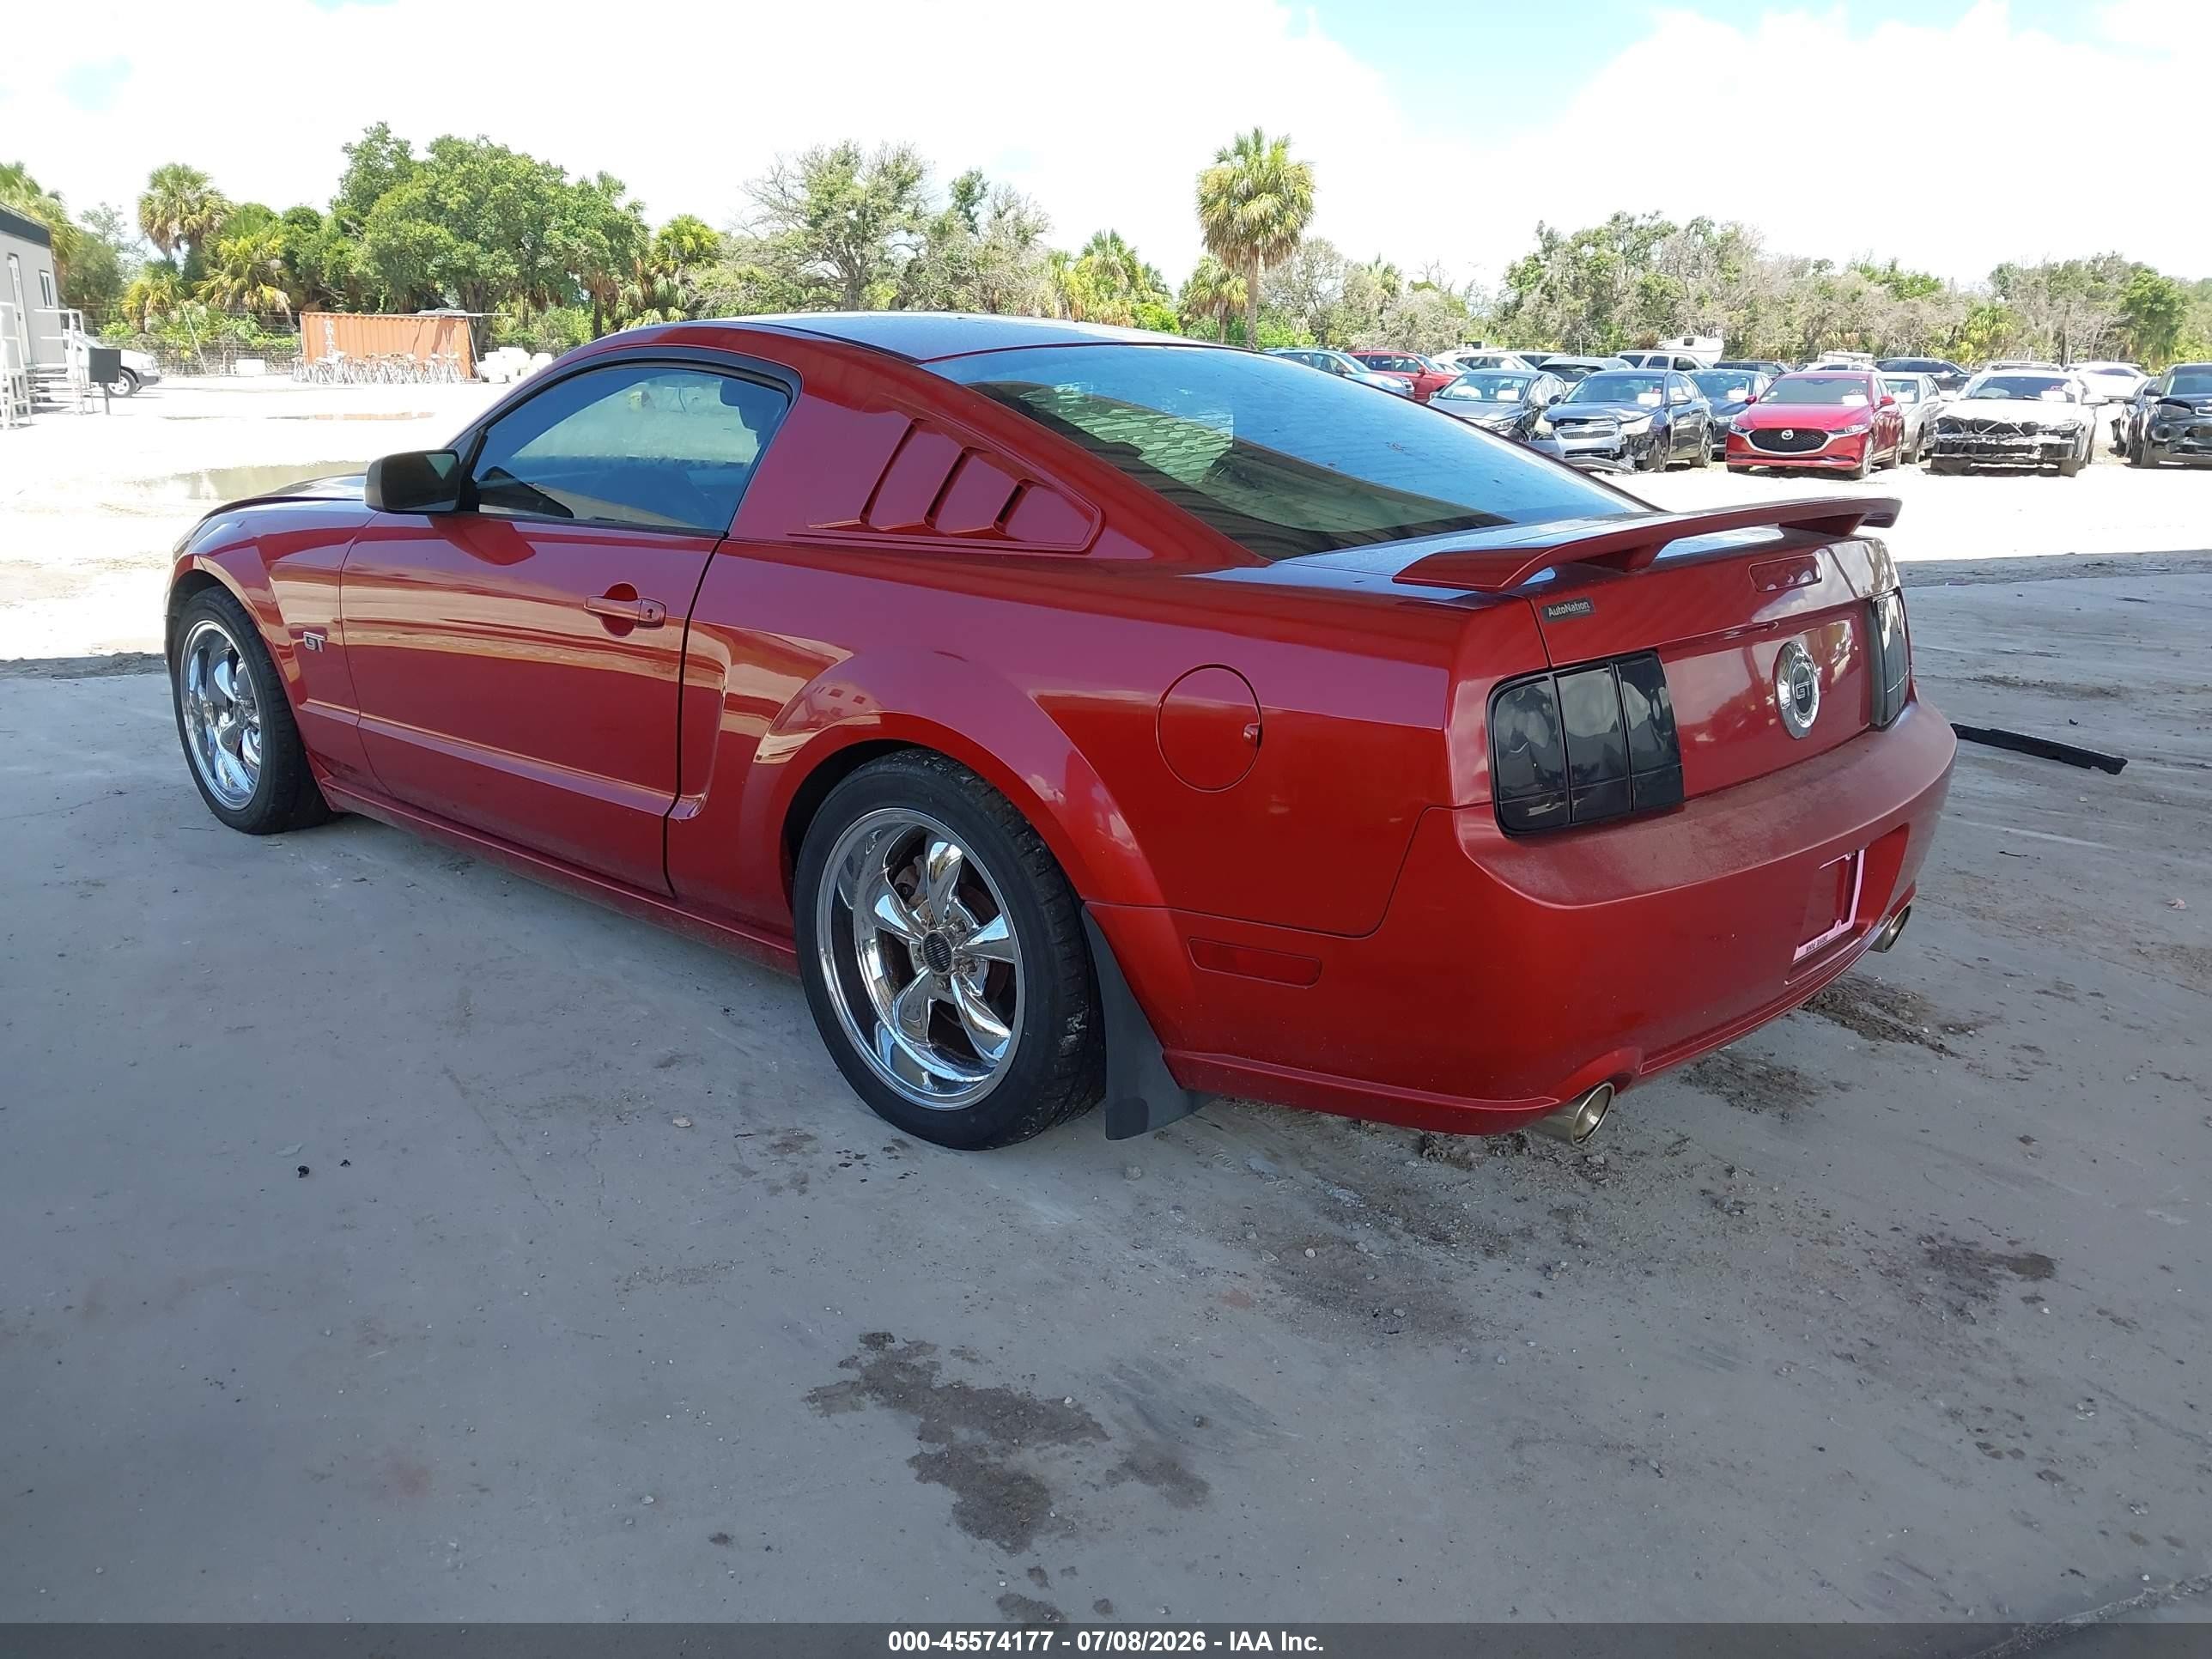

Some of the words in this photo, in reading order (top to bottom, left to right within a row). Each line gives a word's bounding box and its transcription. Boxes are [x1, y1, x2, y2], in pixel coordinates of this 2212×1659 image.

[1547, 601, 1590, 617] AutoNation
[303, 631, 325, 653] GT
[1796, 681, 1811, 700] GT
